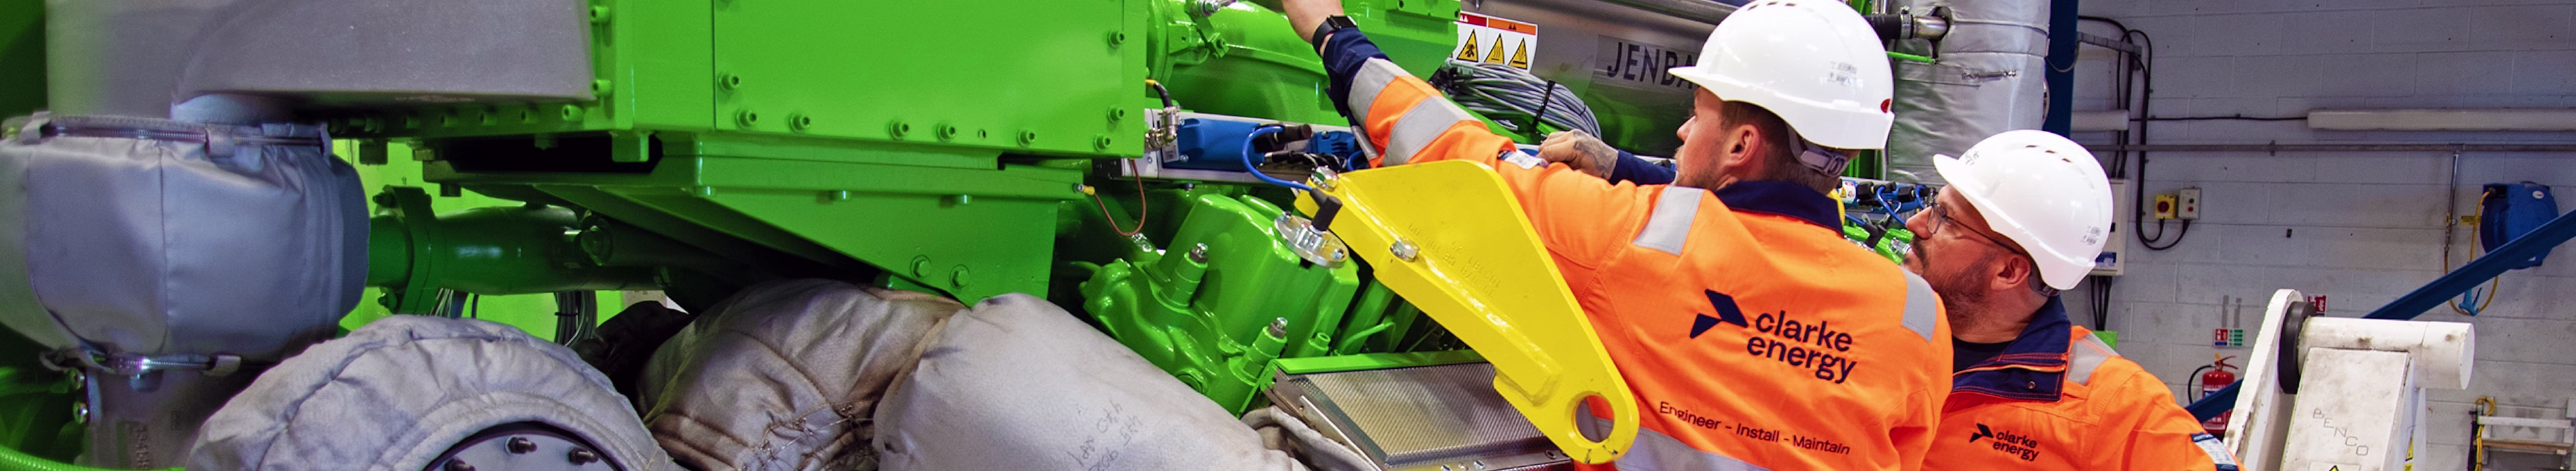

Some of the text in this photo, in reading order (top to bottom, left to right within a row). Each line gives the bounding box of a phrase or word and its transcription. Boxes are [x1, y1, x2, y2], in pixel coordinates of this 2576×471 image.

[1756, 310, 1852, 352] clarke
[1747, 336, 1857, 384] energy
[1660, 401, 1722, 430] Engineer
[1736, 423, 1780, 443] Install
[1792, 434, 1850, 455] Maintain
[1996, 430, 2037, 448] clarke
[2312, 407, 2369, 456] BENCO
[1993, 441, 2039, 462] energy
